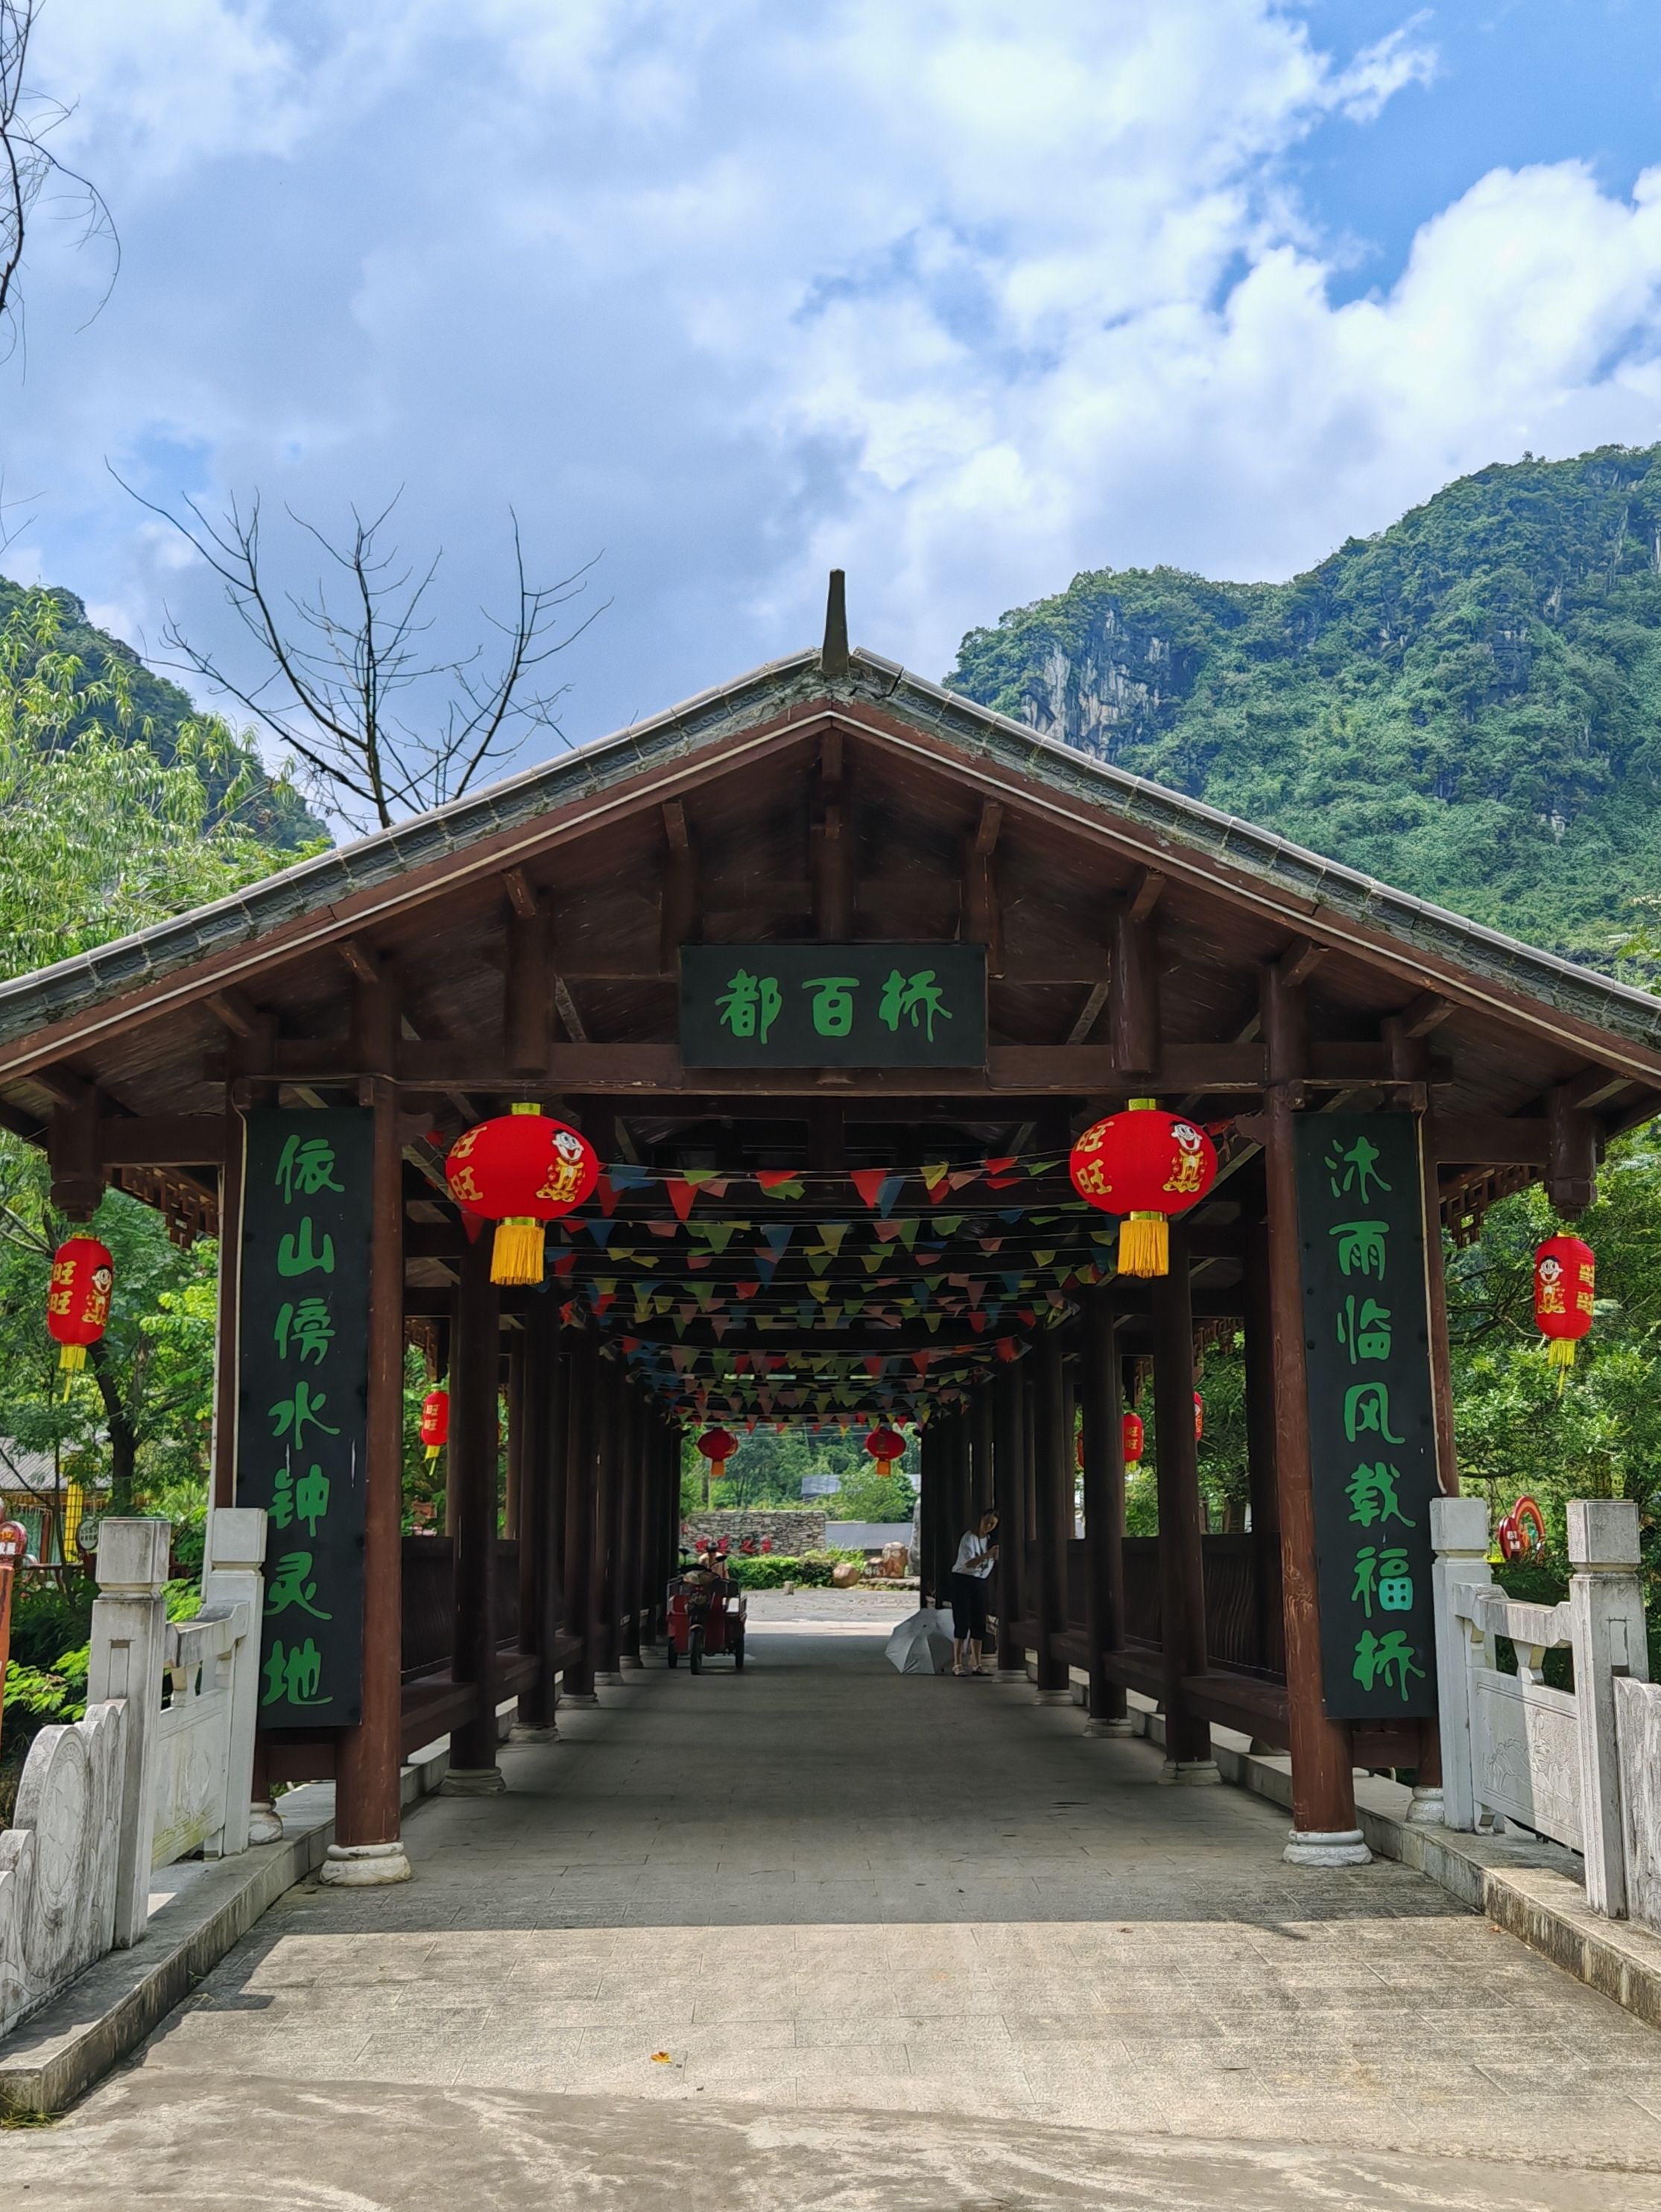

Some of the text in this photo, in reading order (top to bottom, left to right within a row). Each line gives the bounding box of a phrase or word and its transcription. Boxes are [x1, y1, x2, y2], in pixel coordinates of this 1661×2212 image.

[715, 968, 953, 1044] 都百桥
[1075, 1121, 1116, 1195] 旺旺
[48, 1260, 77, 1315] 旺旺
[262, 1134, 345, 1705] 依山傍水钟灵地
[1323, 1136, 1426, 1702] 沐雨临风载福桥
